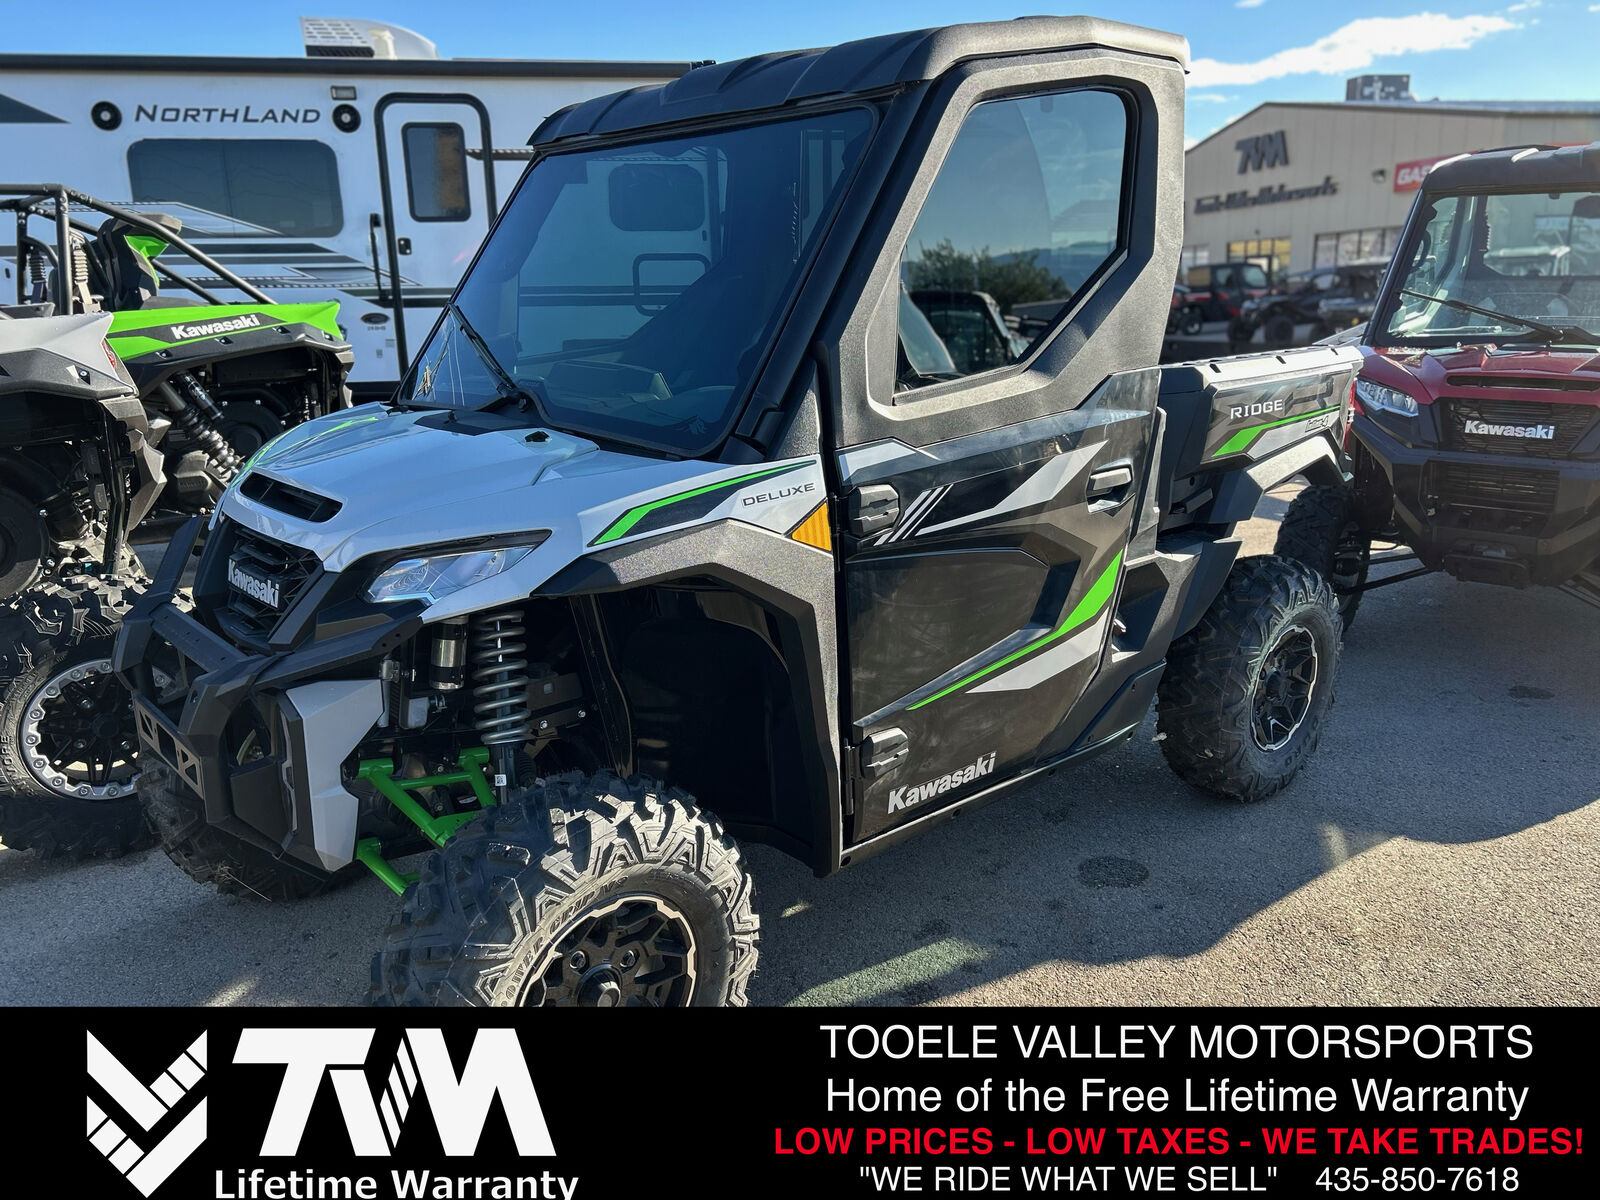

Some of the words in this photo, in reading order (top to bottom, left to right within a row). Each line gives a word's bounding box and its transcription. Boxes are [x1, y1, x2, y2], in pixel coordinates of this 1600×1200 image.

[134, 104, 321, 124] NORTHLAND
[170, 314, 261, 340] Kawasaki
[1230, 399, 1284, 420] RIDGE
[1464, 420, 1555, 440] Kawasaki
[742, 482, 816, 507] DELUXE
[227, 558, 280, 609] Kawasaki
[887, 751, 997, 815] Kawasaki
